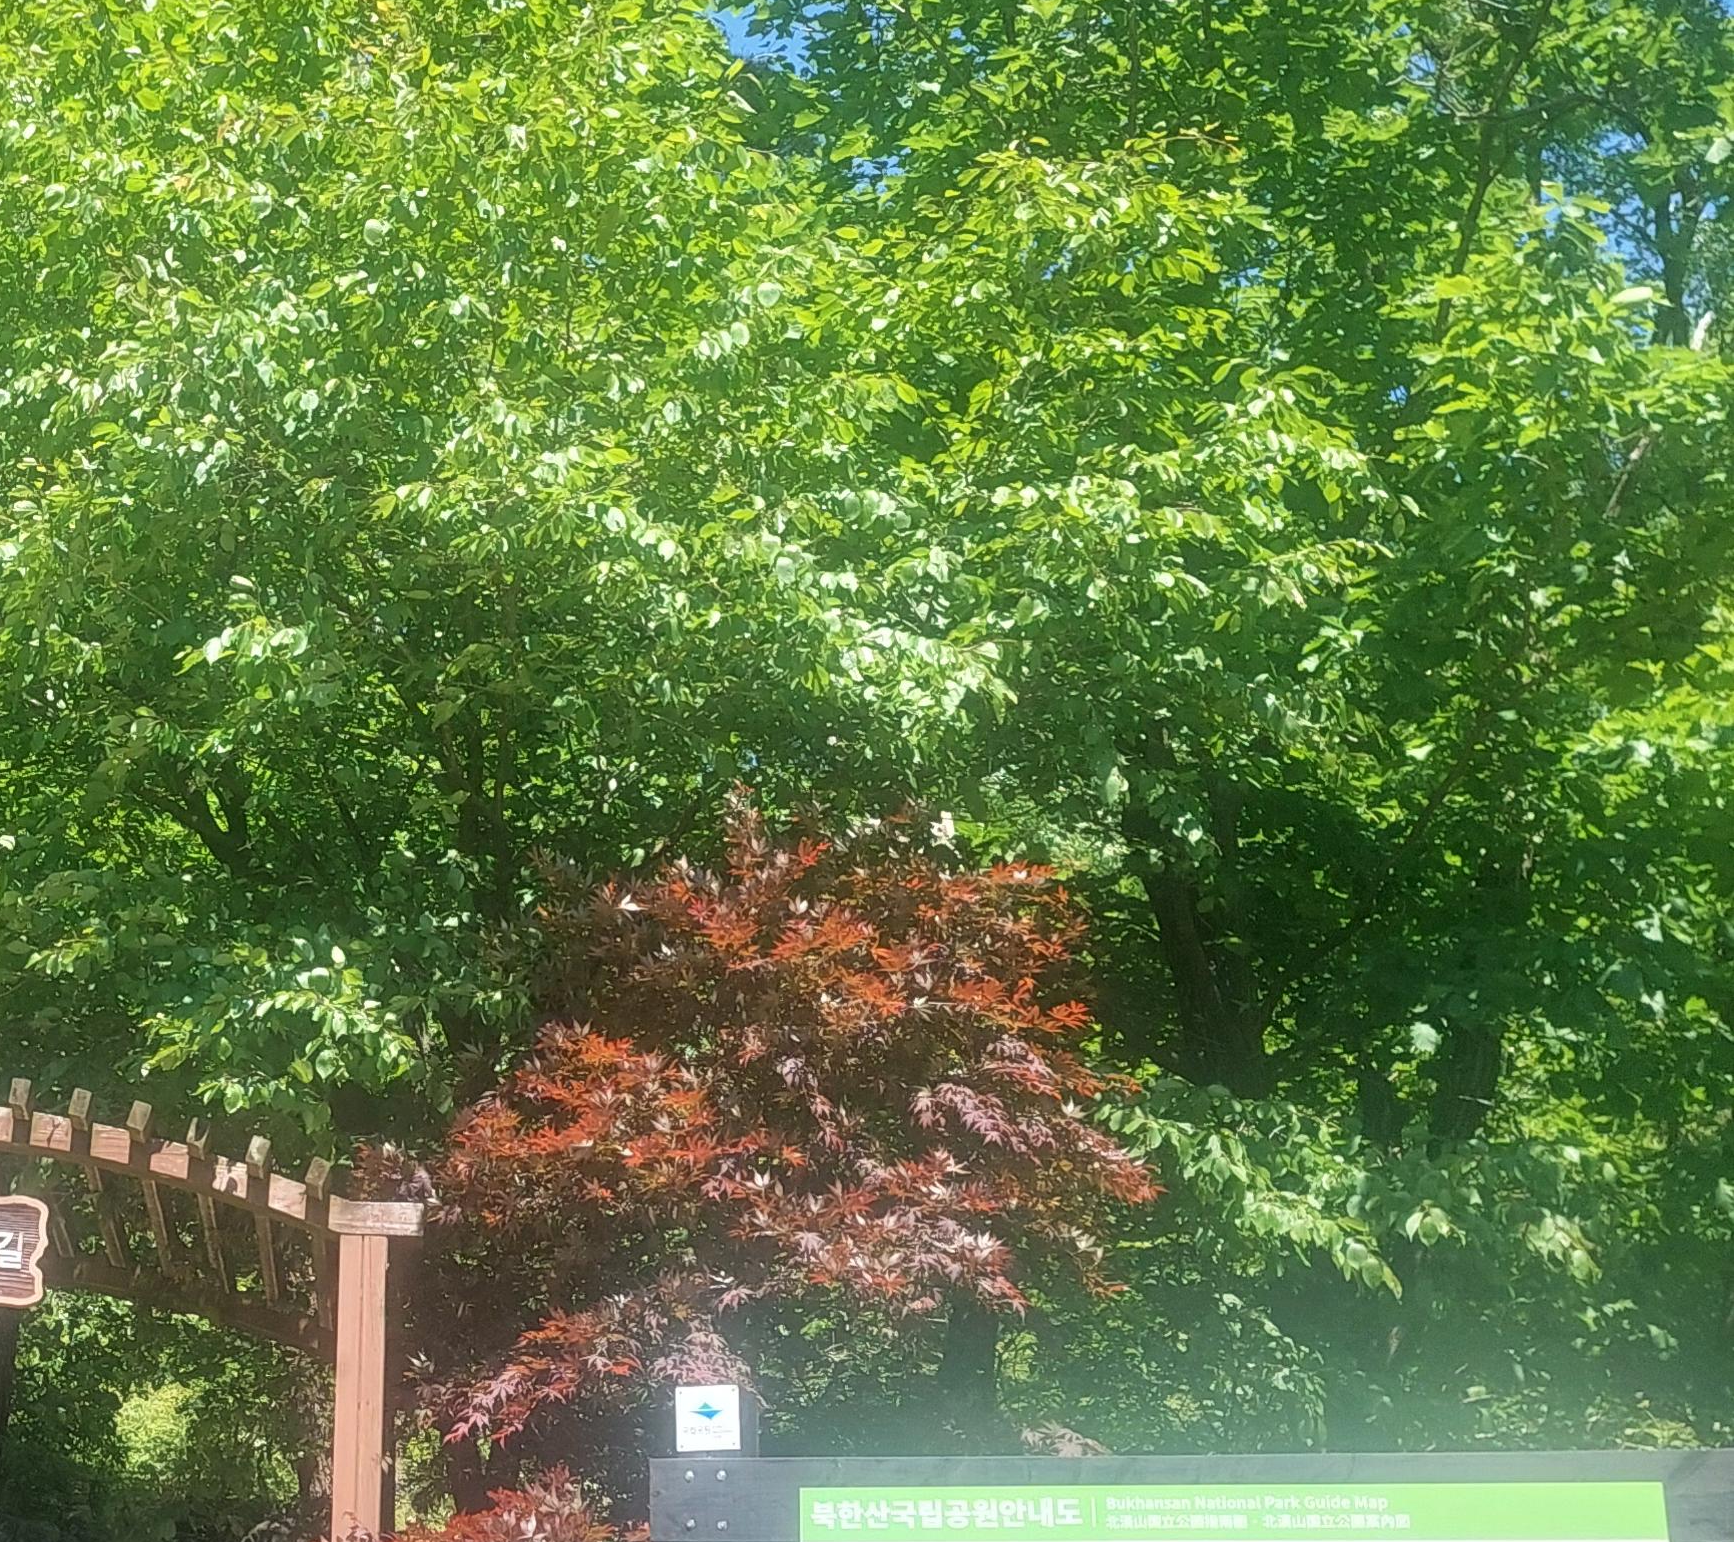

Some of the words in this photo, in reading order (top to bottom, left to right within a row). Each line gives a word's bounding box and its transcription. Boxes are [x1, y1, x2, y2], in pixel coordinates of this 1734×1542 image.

[811, 1497, 1084, 1530] 북한산국립공원안내도
[1106, 1496, 1191, 1510] Bukhansan
[1194, 1496, 1261, 1510] National
[1264, 1496, 1300, 1510] Park
[1304, 1496, 1351, 1510] Guide
[1355, 1496, 1389, 1513] Map
